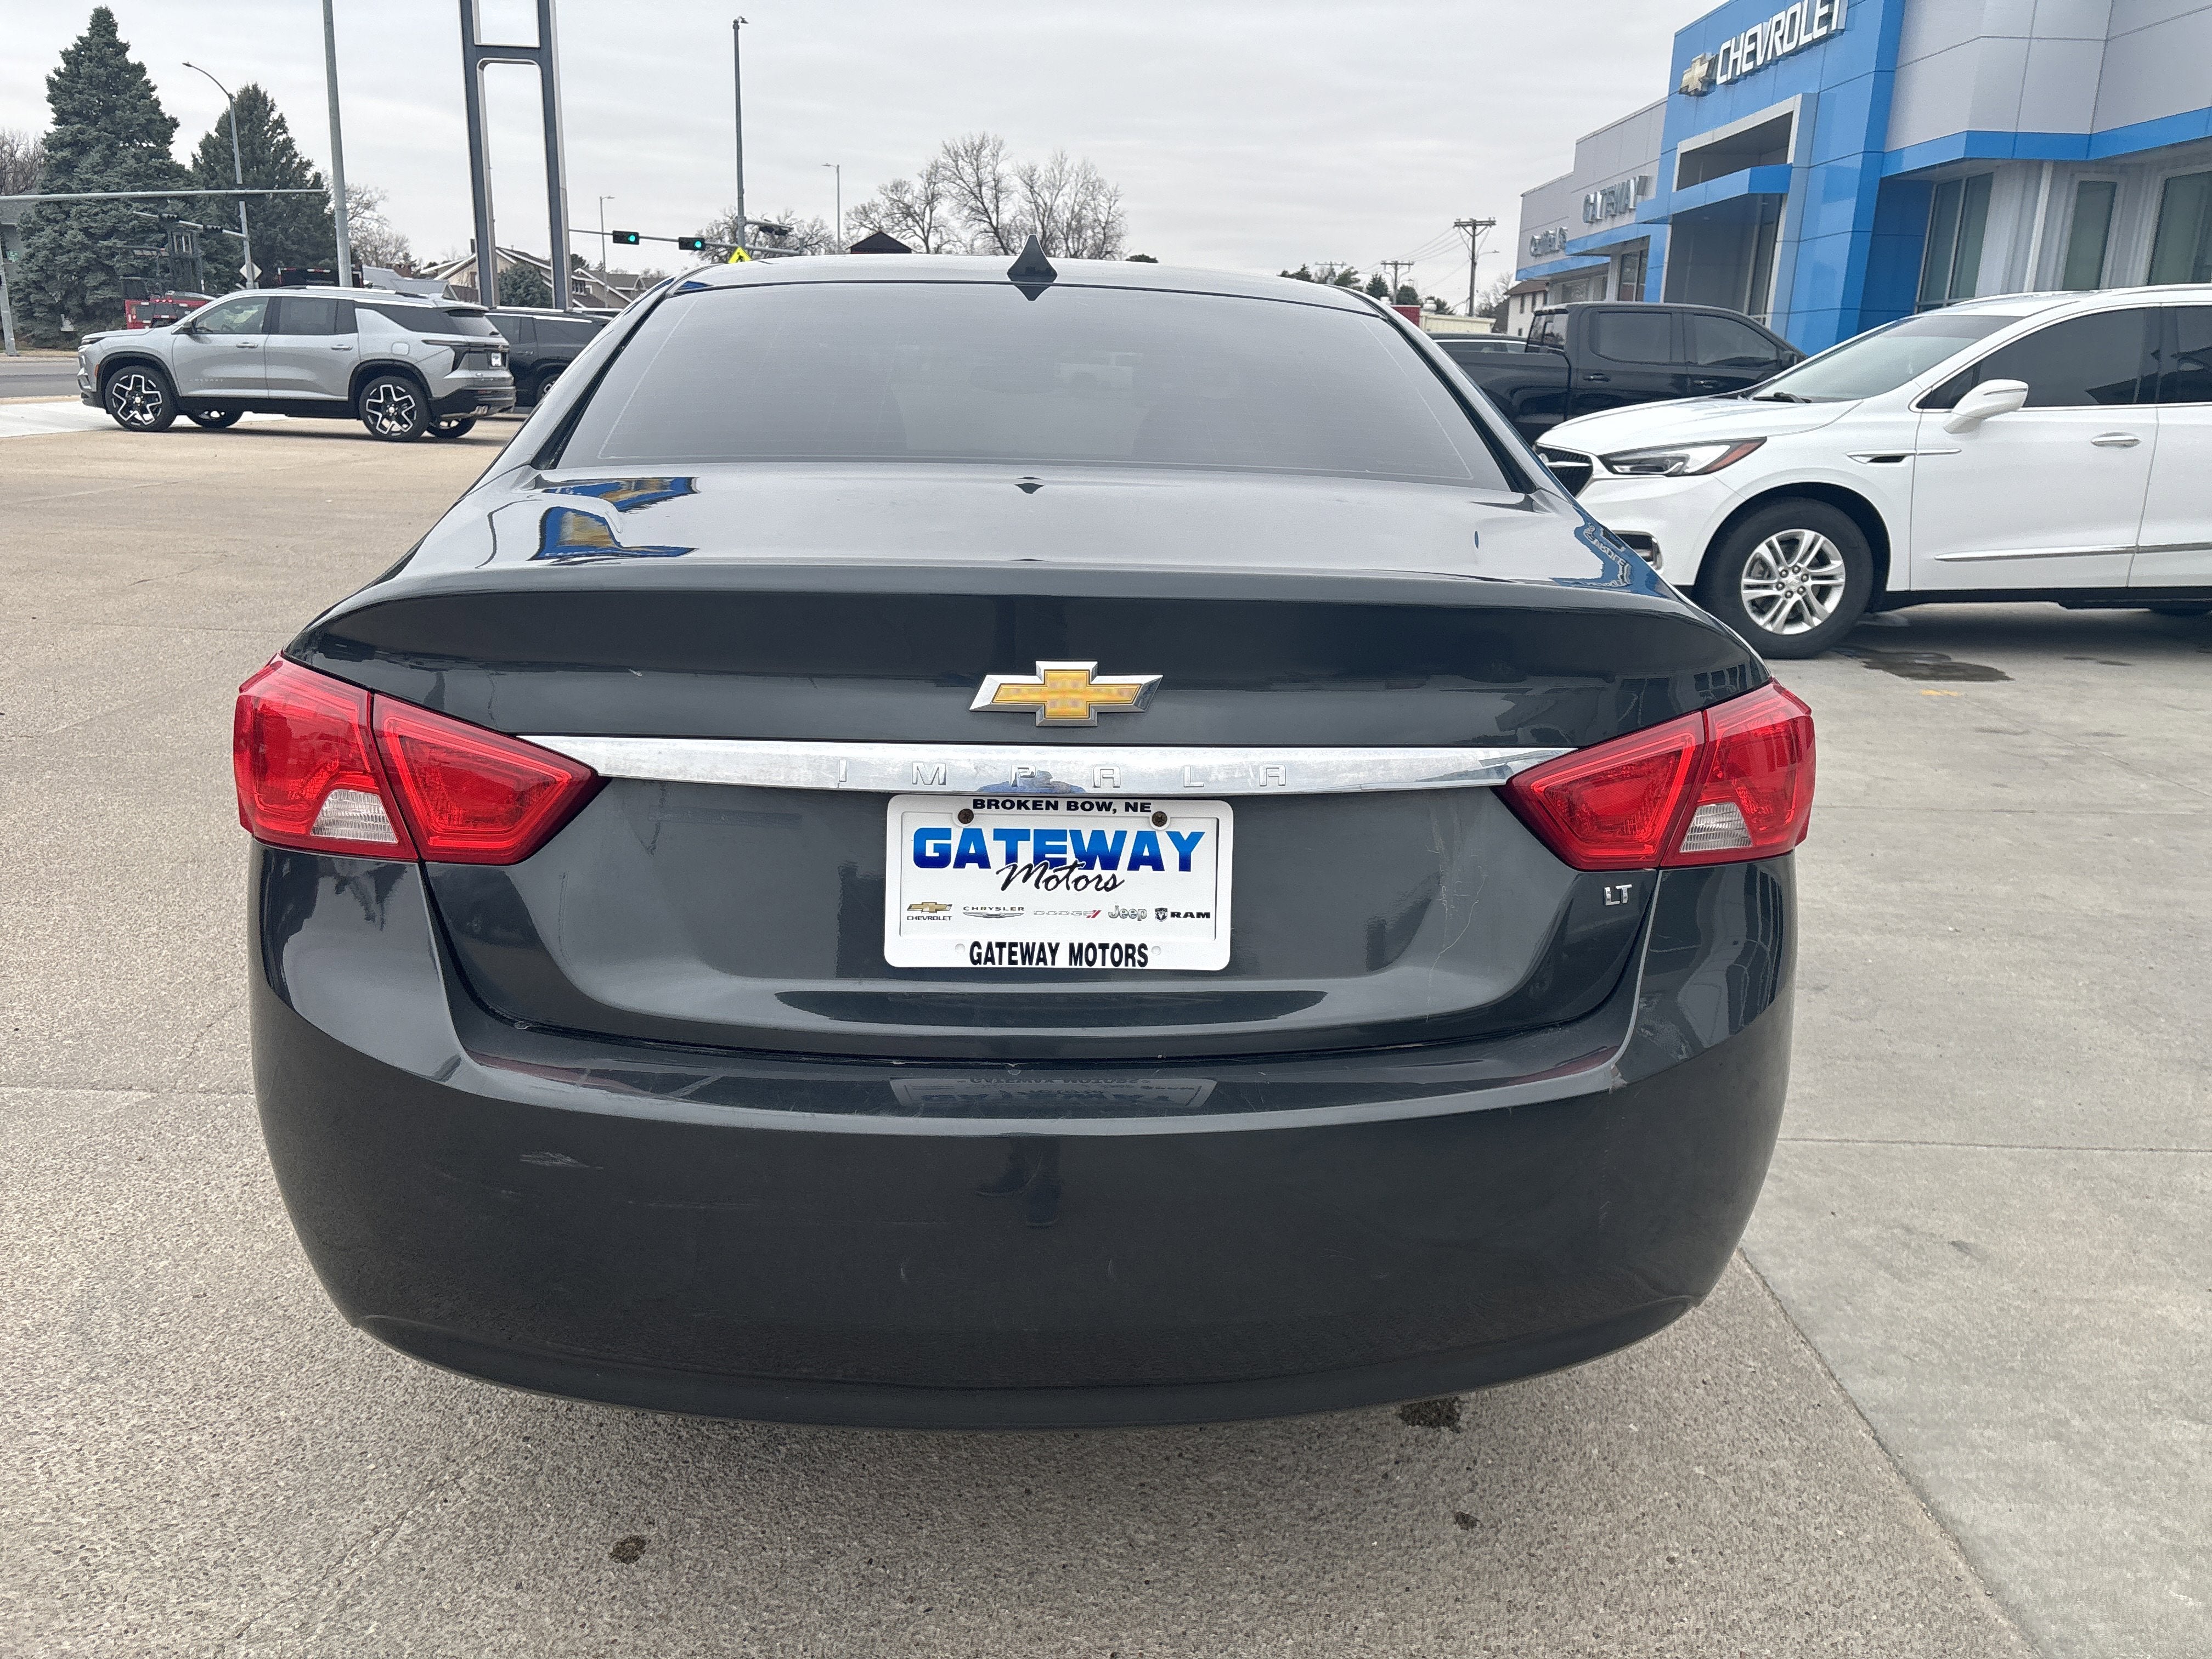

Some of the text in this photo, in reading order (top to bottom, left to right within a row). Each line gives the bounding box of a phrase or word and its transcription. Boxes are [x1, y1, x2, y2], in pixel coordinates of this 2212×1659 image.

[1716, 0, 1843, 85] CHEVROLET
[838, 759, 1286, 788] IMPALA
[973, 799, 1152, 814] BROKEN BOW, NE
[913, 827, 1206, 872] GATEWAY
[995, 859, 1125, 893] Motors
[1604, 884, 1633, 906] LT
[1108, 905, 1148, 922] Jeep
[969, 940, 1149, 968] GATEWAY MOTORS
